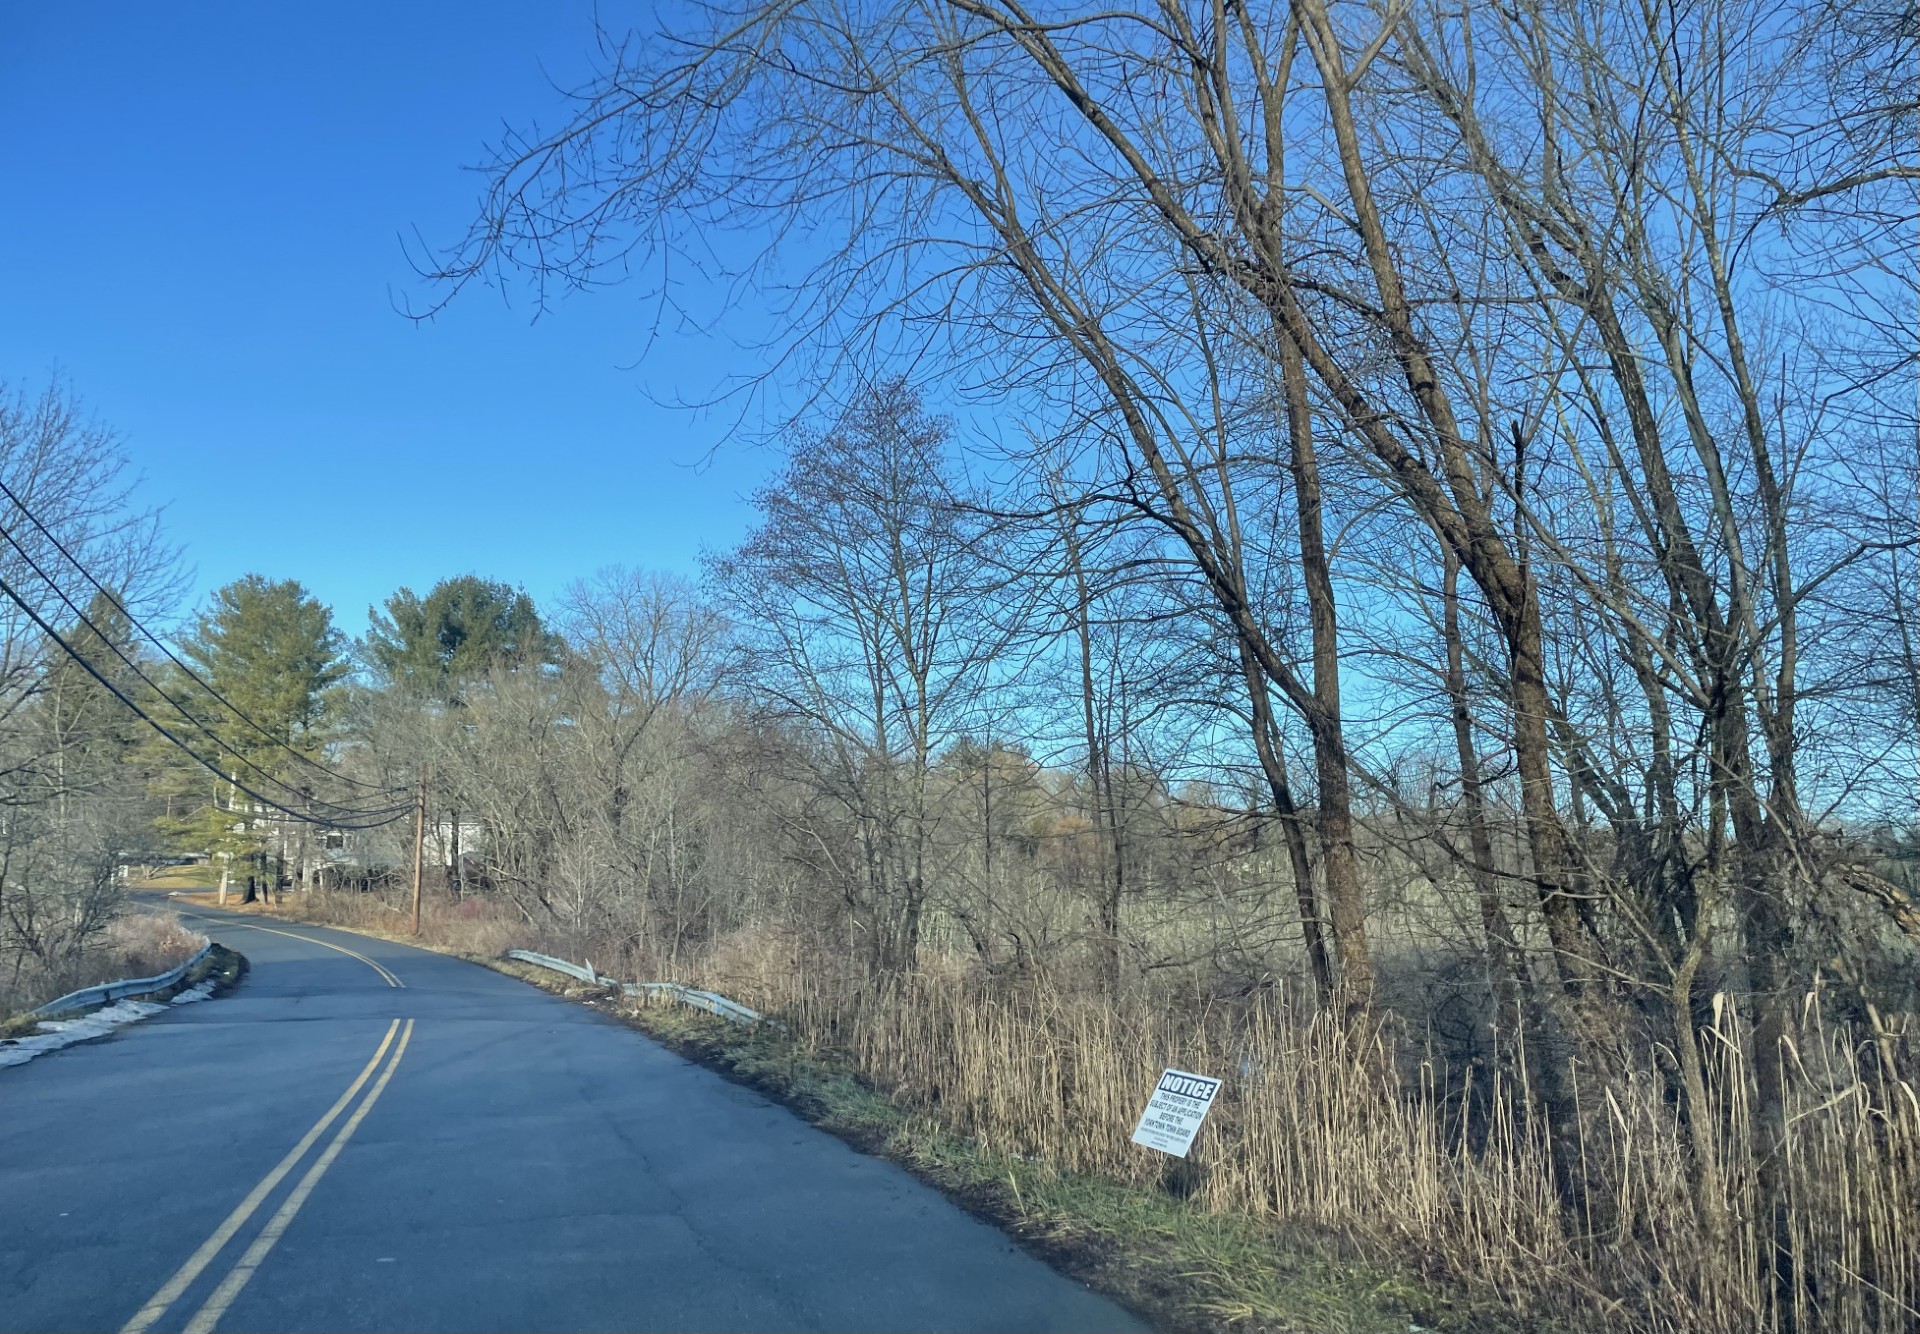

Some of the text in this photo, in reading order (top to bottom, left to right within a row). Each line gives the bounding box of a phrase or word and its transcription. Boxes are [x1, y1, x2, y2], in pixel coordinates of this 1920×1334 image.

[1160, 1074, 1214, 1100] NOTICE
[1160, 1092, 1170, 1101] THIS
[1191, 1100, 1202, 1109] THE
[1149, 1099, 1168, 1109] SUBJECT
[1177, 1107, 1203, 1120] APPLICATION
[1159, 1112, 1184, 1125] BEFORE THE
[1165, 1123, 1177, 1133] TOWN
[1175, 1127, 1191, 1138] BOARD
